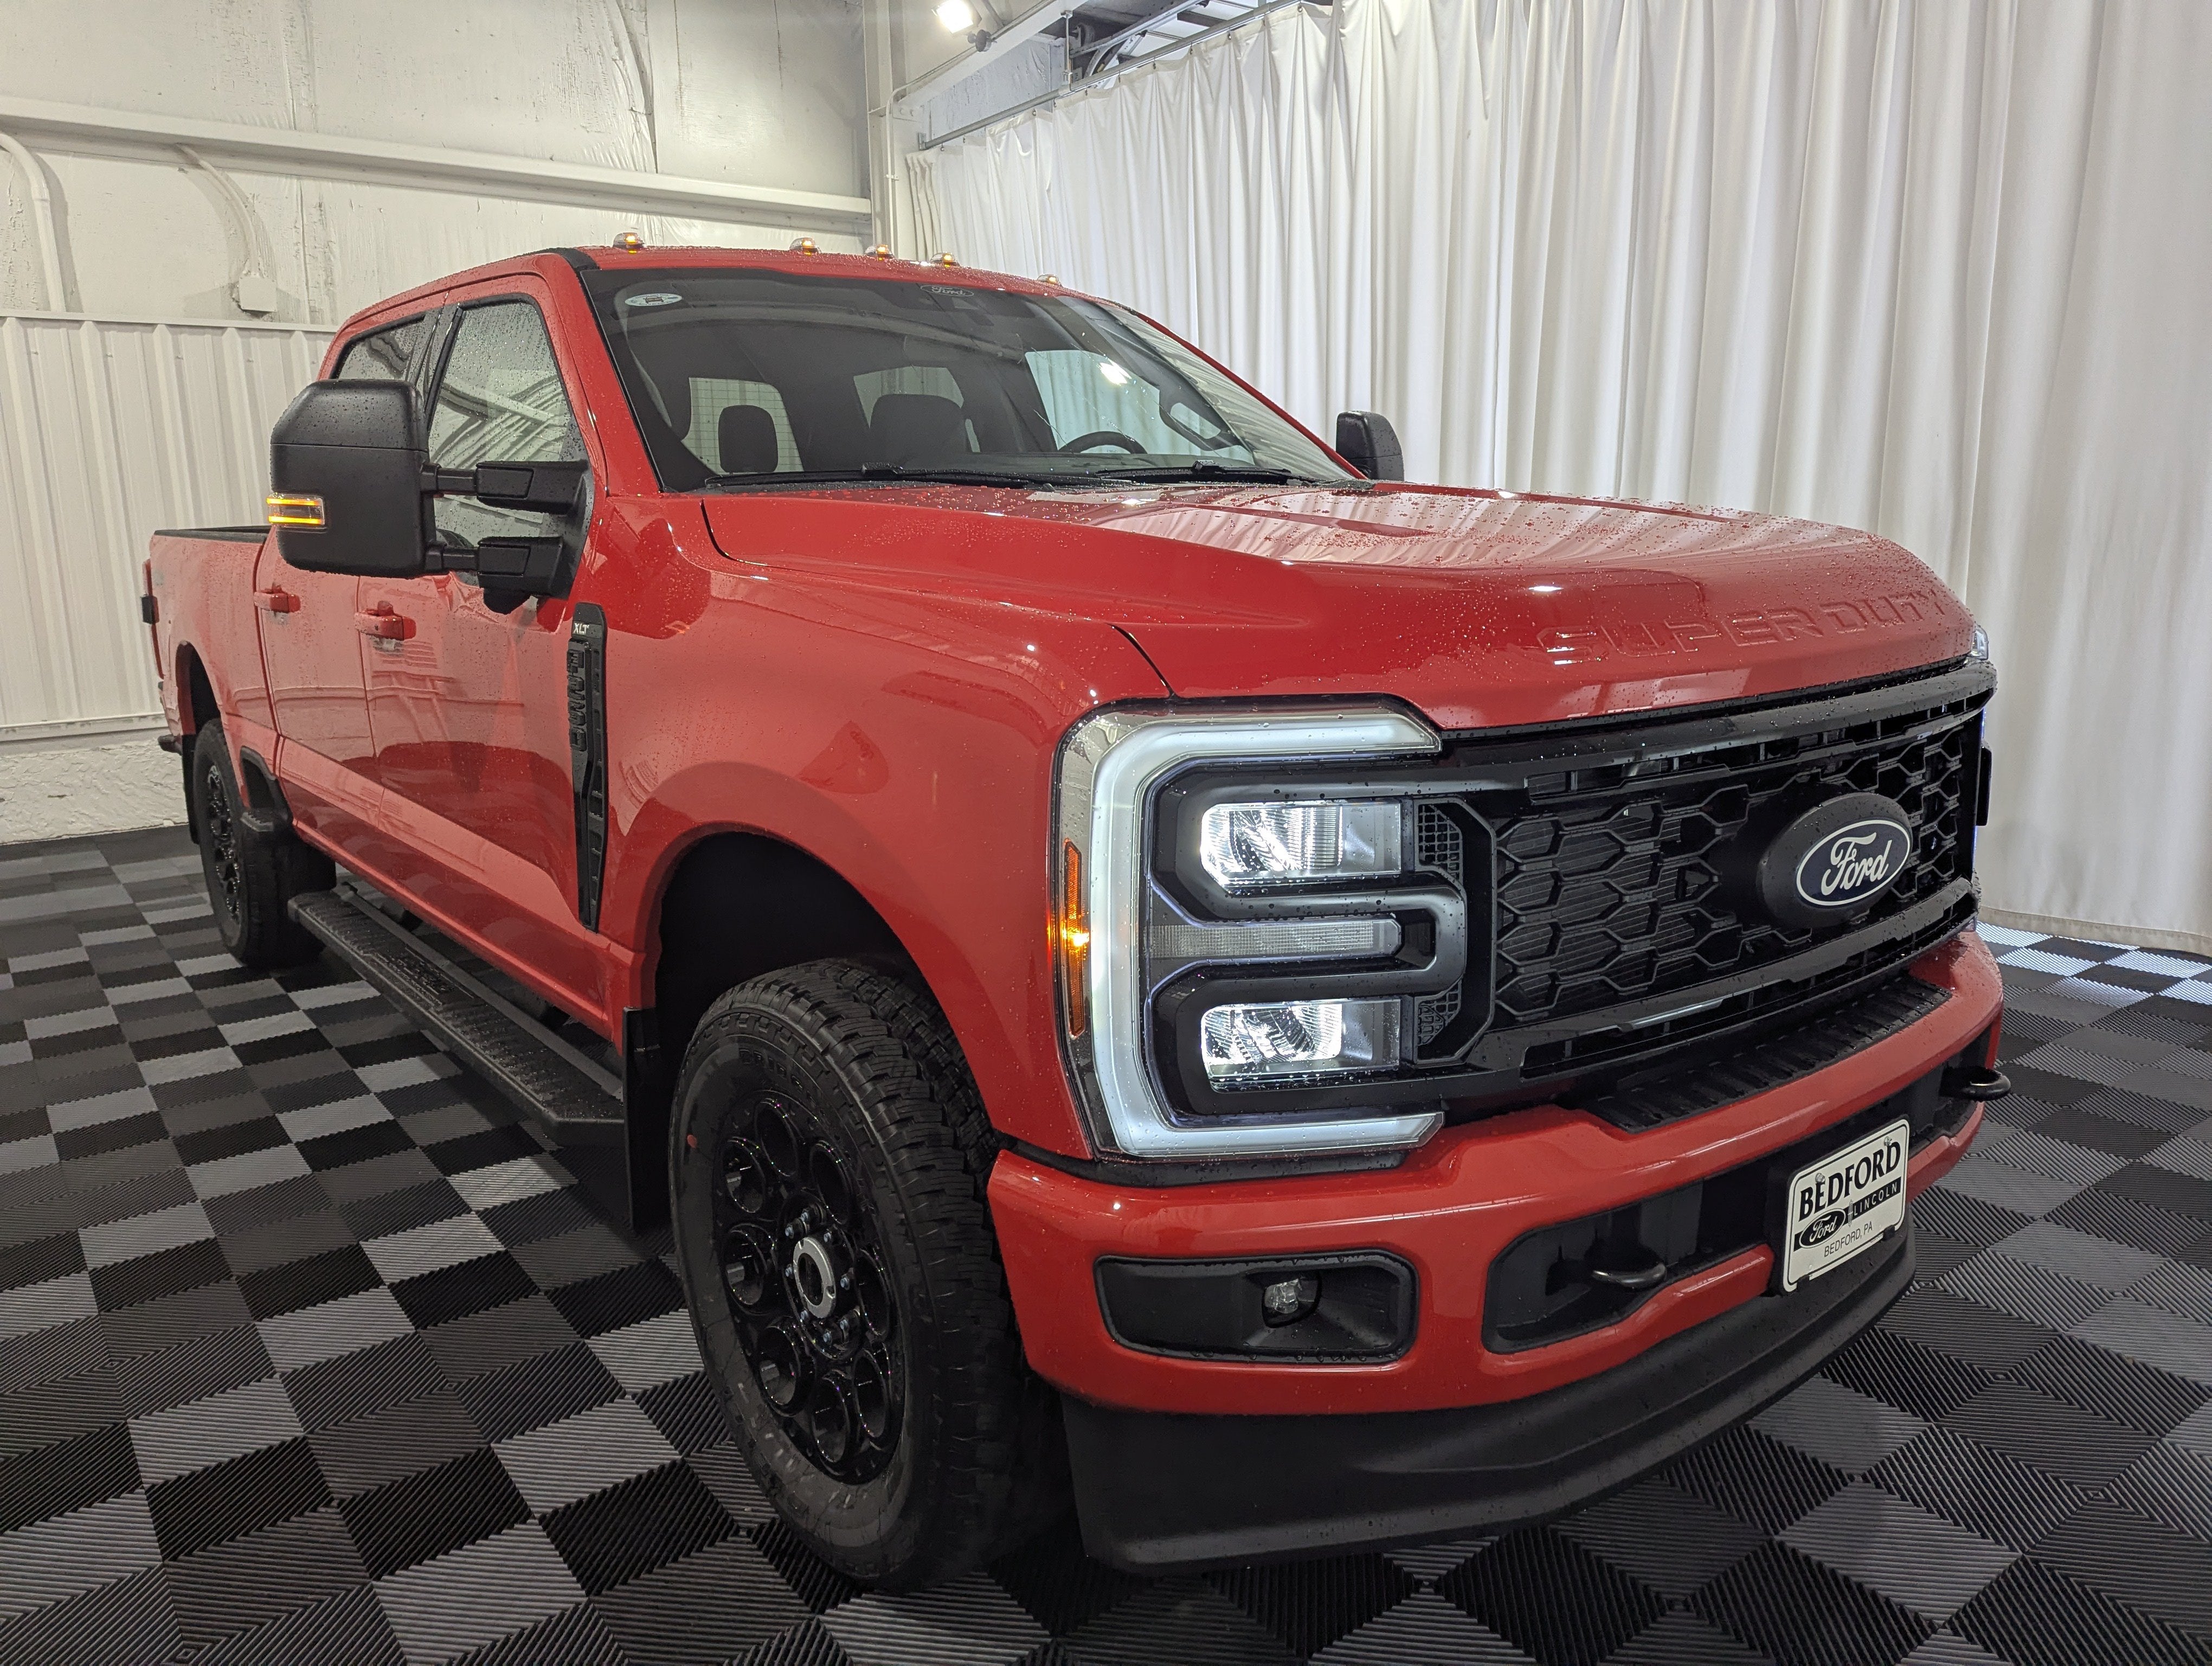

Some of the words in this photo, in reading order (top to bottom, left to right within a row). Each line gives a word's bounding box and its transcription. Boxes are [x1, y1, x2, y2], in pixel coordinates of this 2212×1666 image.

[931, 285, 966, 296] Ford
[573, 622, 590, 635] XLT
[1536, 605, 1824, 665] SUPER
[1819, 588, 1945, 634] DUTY
[1821, 832, 1893, 895] Ford
[1798, 1140, 1901, 1222] BEDFORD
[1854, 1183, 1898, 1216] LINCOLN
[1809, 1214, 1838, 1243] Ford
[1824, 1228, 1862, 1258] BEDFORD,
[1863, 1221, 1873, 1235] PA
